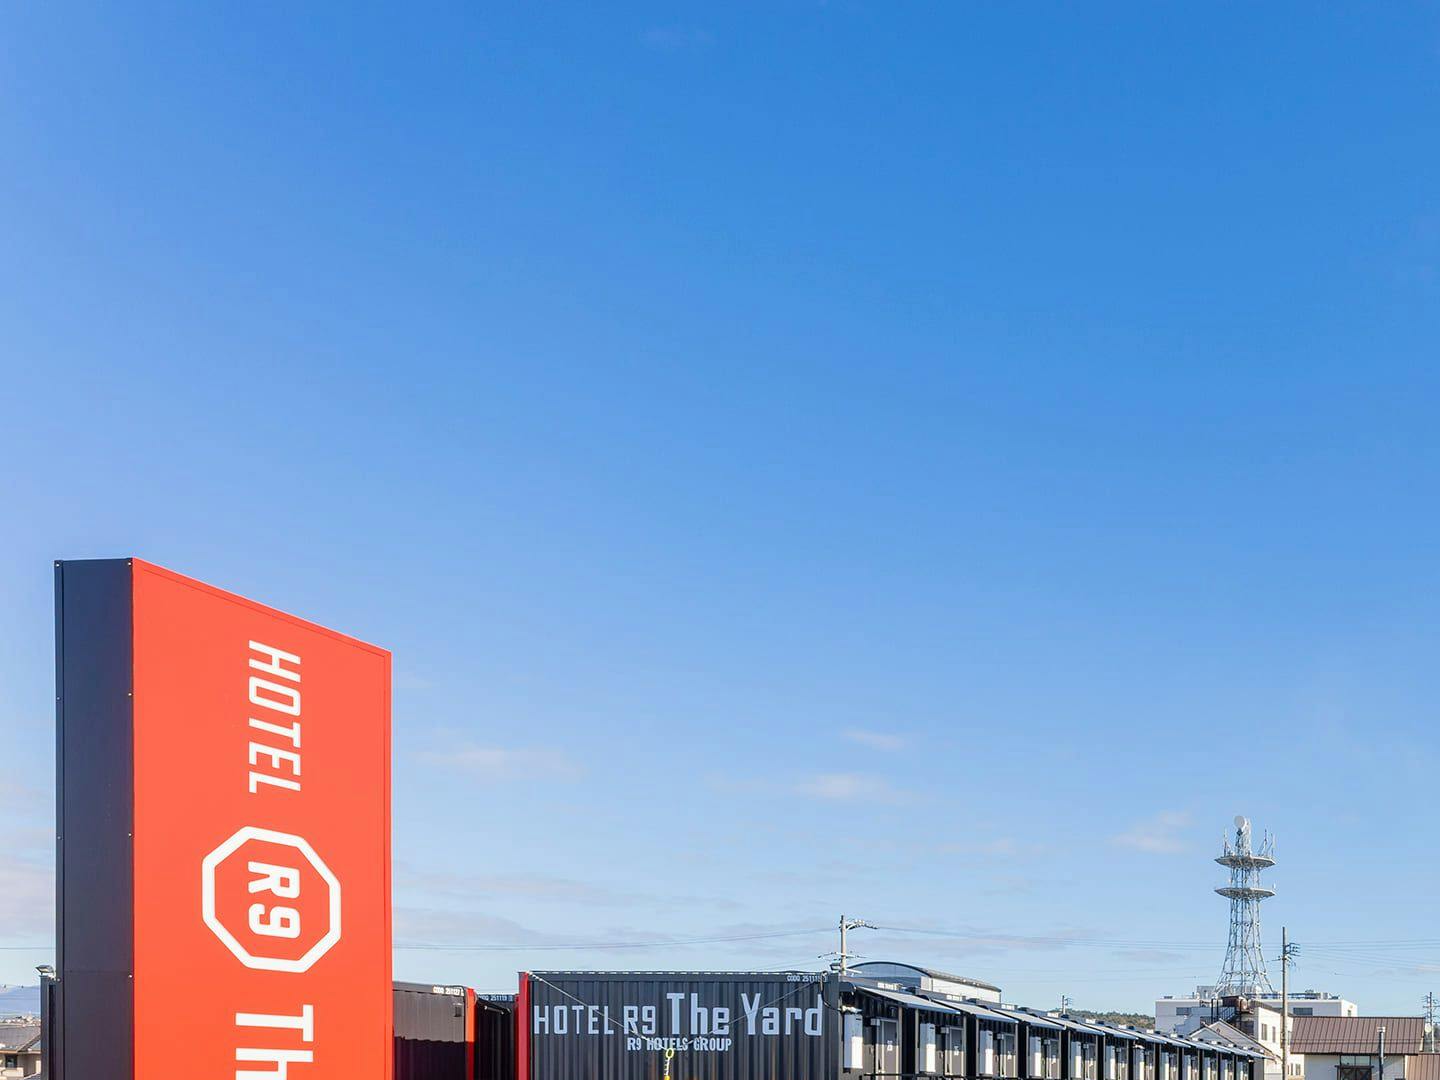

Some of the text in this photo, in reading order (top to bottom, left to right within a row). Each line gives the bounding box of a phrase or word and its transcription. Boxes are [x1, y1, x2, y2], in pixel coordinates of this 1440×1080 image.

[249, 640, 301, 793] HOTEL
[248, 861, 300, 938] R9
[533, 992, 823, 1036] HOTEL R9 The Yard
[627, 1037, 732, 1051] R9 HOTELS GROUP
